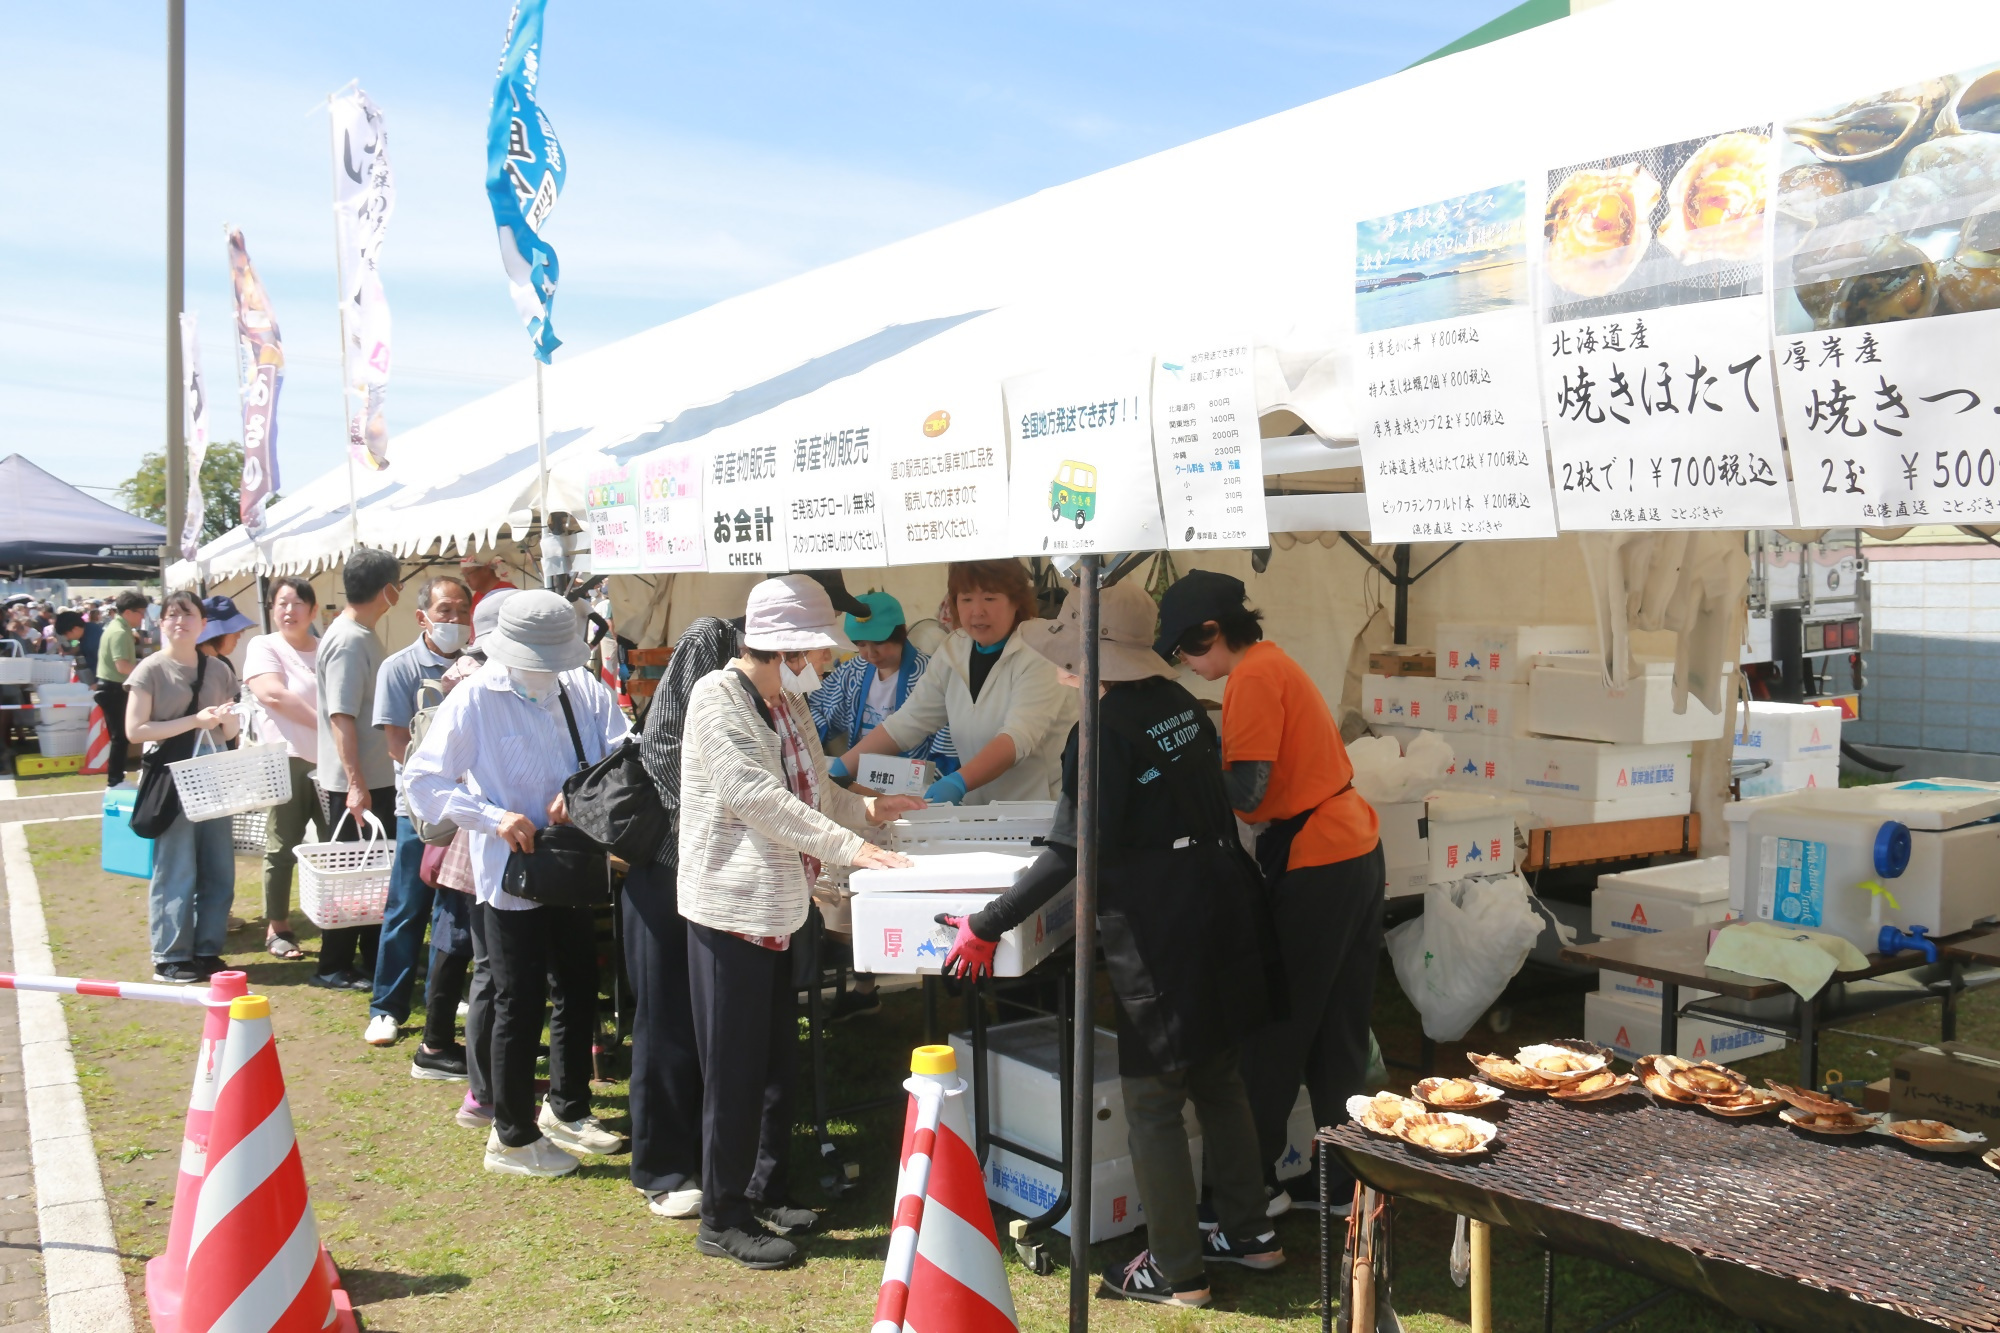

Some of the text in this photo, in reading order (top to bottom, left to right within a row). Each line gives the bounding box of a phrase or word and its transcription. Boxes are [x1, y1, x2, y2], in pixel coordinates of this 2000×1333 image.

[1431, 326, 1480, 347] ¥800税込
[1552, 318, 1649, 356] 北海道産
[1782, 331, 1882, 371] 厚岸産
[1557, 354, 1762, 425] 焼きほたて
[1021, 395, 1138, 440] 全国地方発送できます！！
[1168, 397, 1230, 412] 北海道内 800円
[1804, 375, 2000, 437] 焼きつ
[1168, 413, 1235, 429] 関東地方 1400円
[792, 425, 870, 473] 海産物販売
[1171, 429, 1239, 445] 九州四国 2000円
[890, 446, 994, 481] 道の駅売店にも厚岸加工品を
[1214, 445, 1241, 456] 2300円
[1379, 450, 1530, 476] 北海道産焼きほたて2枚¥700税込
[711, 444, 777, 485] 海産物販売
[1175, 462, 1205, 475] クール料金
[1562, 452, 1778, 492] 2枚で！ ¥700税込
[1821, 448, 2000, 494] 2玉 ¥500
[1223, 476, 1241, 485] 210円
[904, 485, 977, 512] 販売しておりますので
[1225, 491, 1243, 500] 310円
[1187, 505, 1244, 516] 大 610円
[1610, 505, 1724, 522] 漁港直送 ことぶきや
[1862, 500, 1930, 518] 漁港直送
[713, 506, 774, 544] お会計
[906, 517, 979, 542] お立ち寄りください。
[1412, 520, 1503, 536] 漁港直送 ことぶきや
[791, 528, 884, 554] スタッフにお申し付けください。
[728, 551, 763, 566] CHECK
[869, 770, 895, 785] 受付窓口
[883, 928, 904, 958] 厚
[1112, 1196, 1127, 1223] 厚
